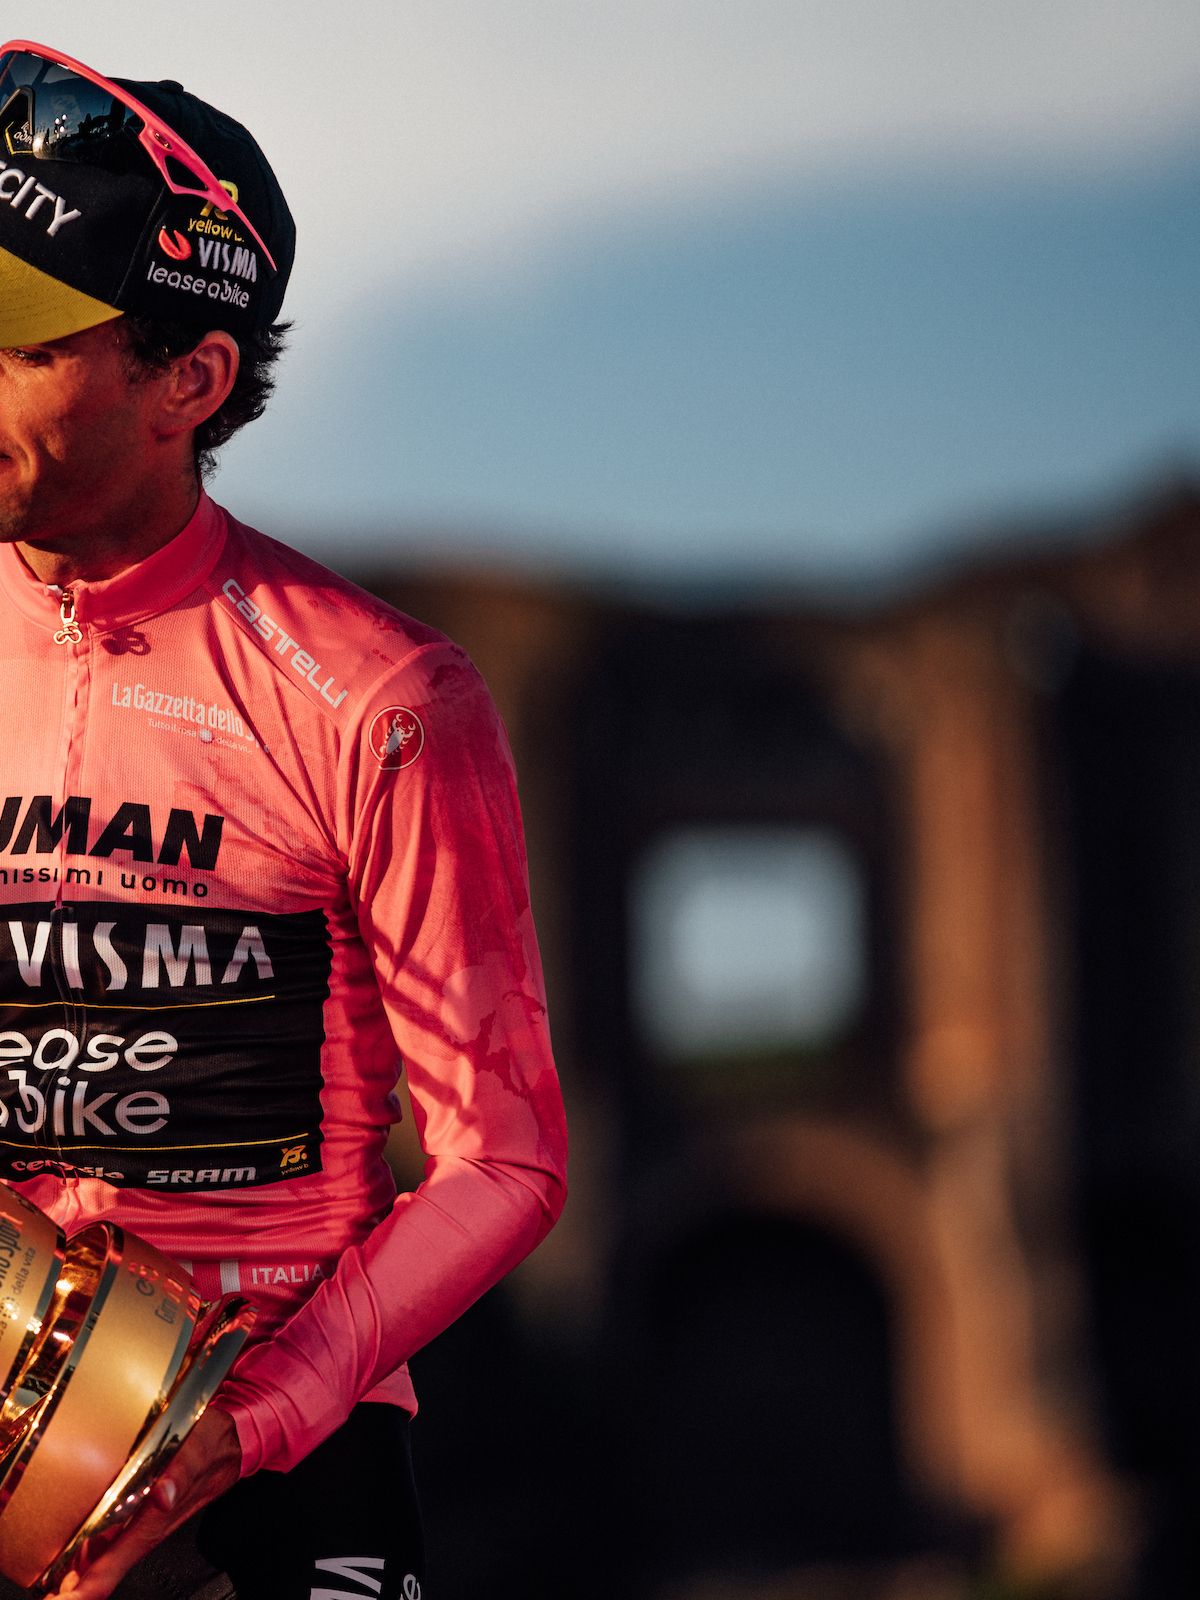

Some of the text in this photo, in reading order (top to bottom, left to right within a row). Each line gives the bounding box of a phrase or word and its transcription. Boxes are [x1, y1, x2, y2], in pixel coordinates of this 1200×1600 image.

[188, 218, 234, 239] yellow
[198, 237, 257, 283] VISMA
[147, 261, 206, 294] lease
[133, 683, 205, 726] Gazzetta
[120, 873, 208, 898] uomo
[7, 920, 275, 991] VISMA
[146, 1166, 256, 1184] SRAM
[10, 1266, 29, 1295] della
[252, 1263, 327, 1286] ITALIA
